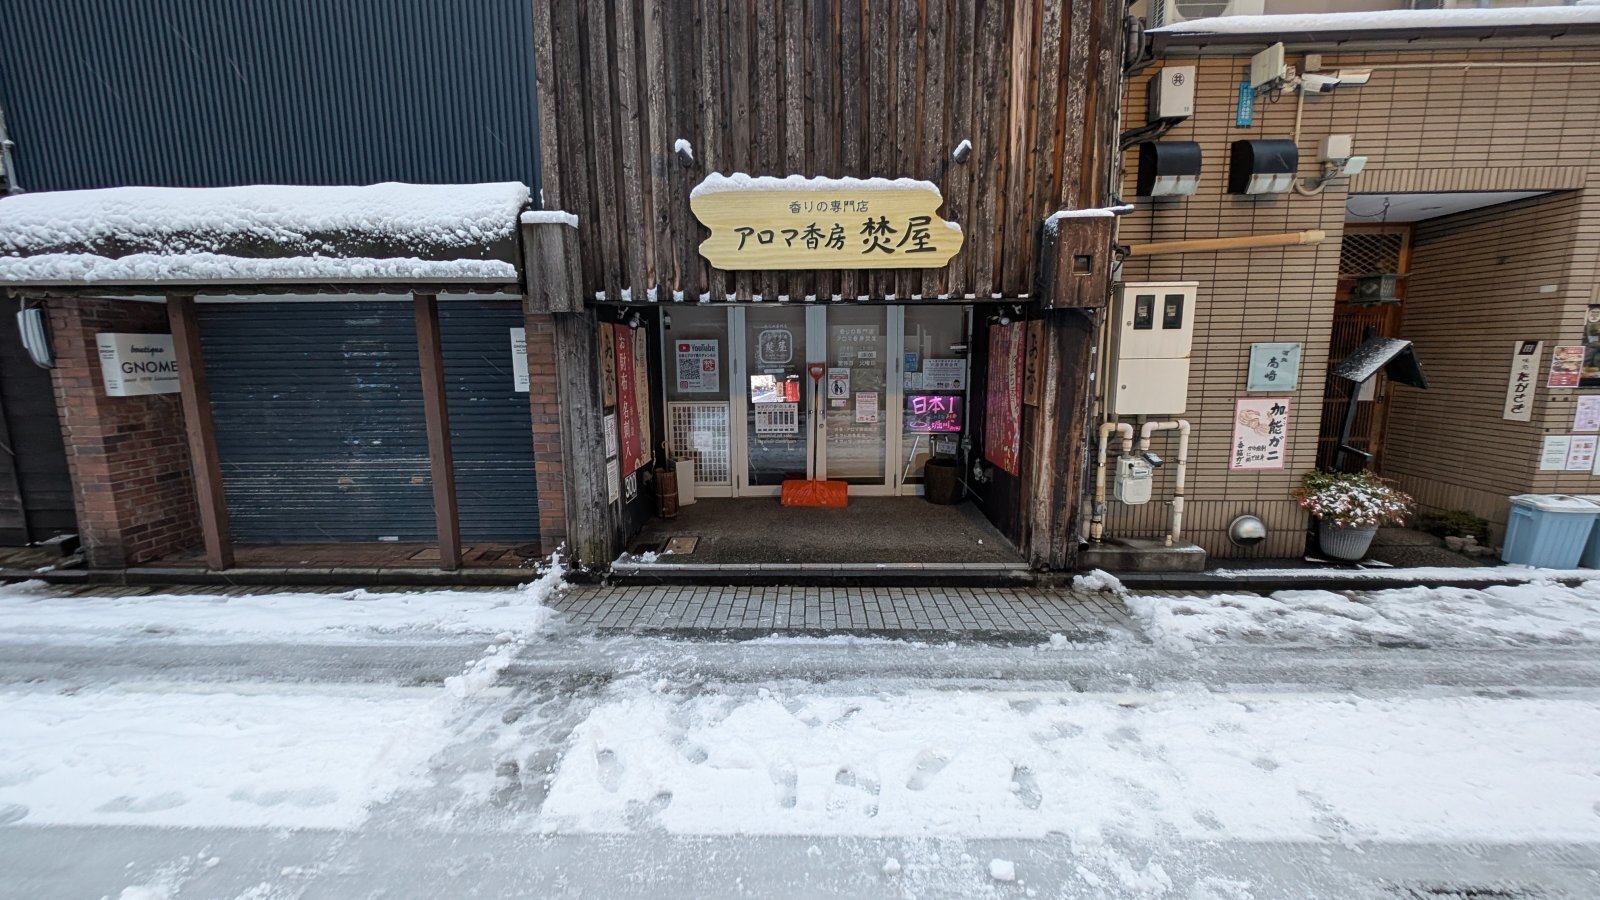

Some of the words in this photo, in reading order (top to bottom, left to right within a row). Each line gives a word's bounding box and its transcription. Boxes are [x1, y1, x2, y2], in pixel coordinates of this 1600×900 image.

[789, 200, 869, 213] 香りの専門店
[130, 344, 165, 356] boutique
[691, 343, 716, 352] YouTube
[121, 360, 178, 374] GNOME
